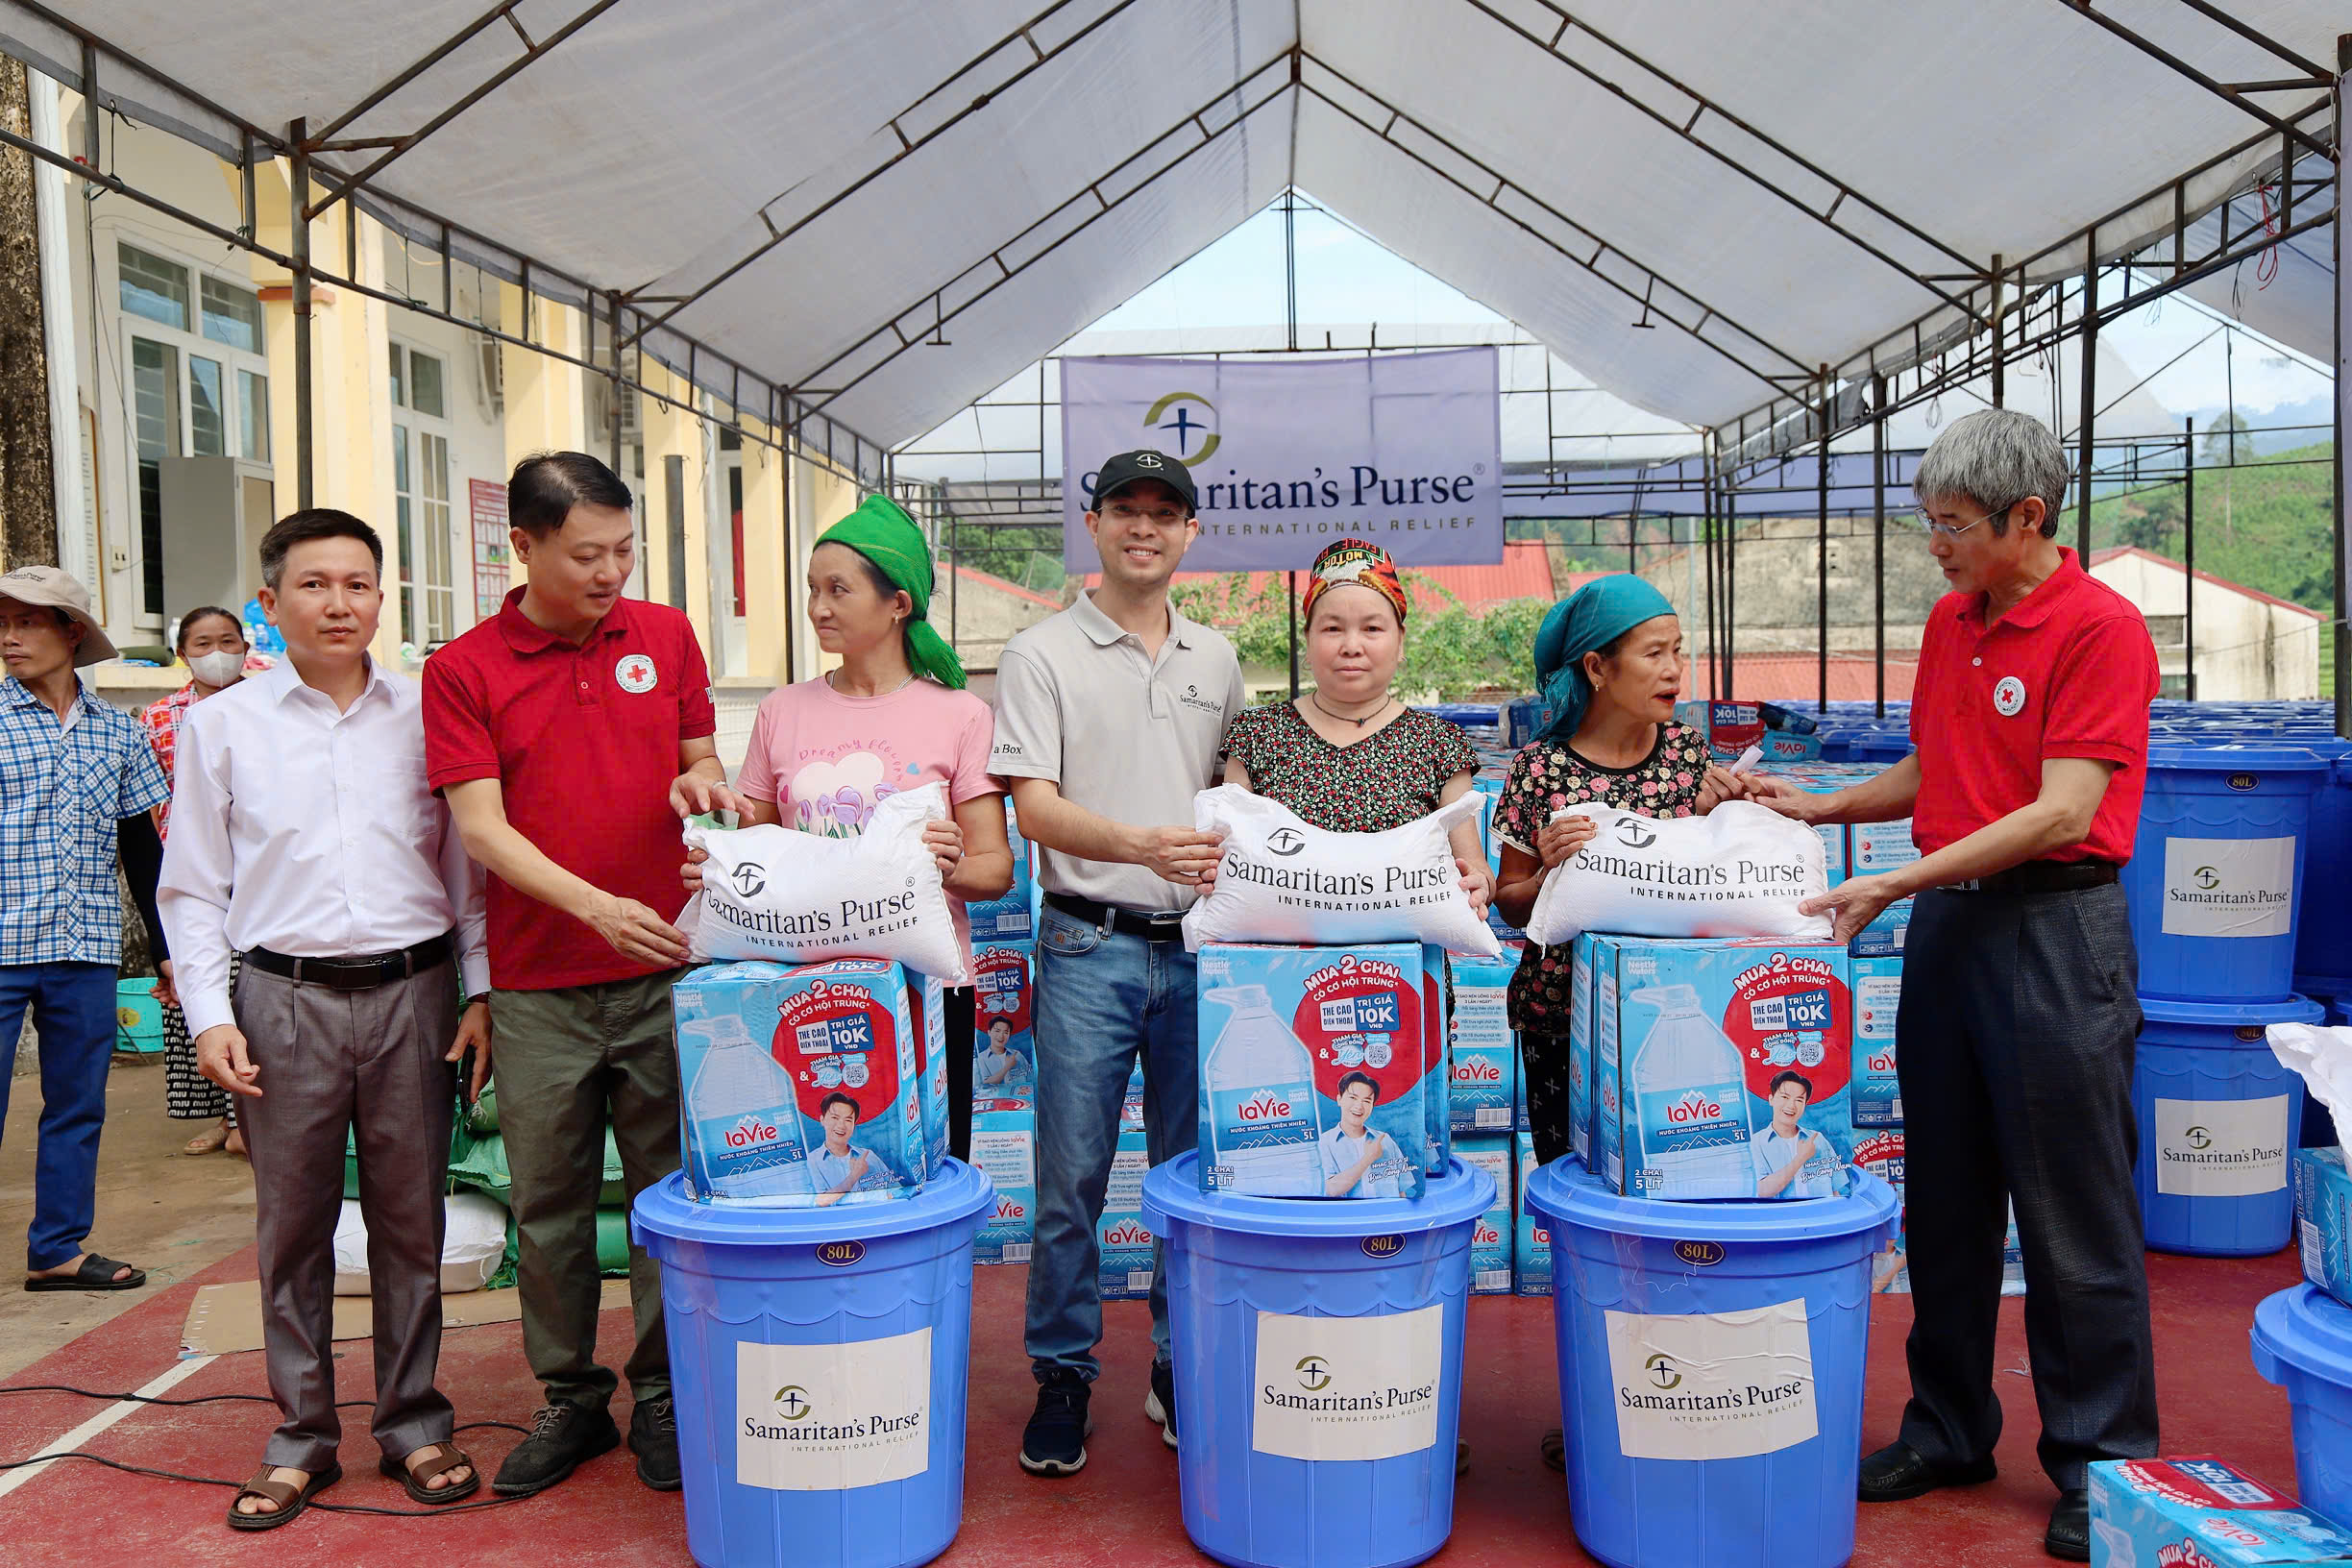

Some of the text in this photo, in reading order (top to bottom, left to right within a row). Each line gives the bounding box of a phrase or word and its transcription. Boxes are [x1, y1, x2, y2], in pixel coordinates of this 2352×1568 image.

[1197, 517, 1476, 536] NTERNATIONAL RELIEF
[1324, 551, 1363, 570] MOTOR
[1715, 708, 1737, 718] 10K
[1002, 744, 1022, 755] Box
[1775, 742, 1806, 754] laVie
[2232, 776, 2252, 787] 80L
[1225, 852, 1374, 895] Samaritan's
[1575, 847, 1727, 886] Samaritan's
[1278, 892, 1453, 912] INTERNATIONAL RELIEF
[1630, 886, 1806, 901] INTERNATIONAL RELIEF
[2169, 887, 2256, 904] Samaritan's
[746, 916, 919, 949] INTERNATIONAL RELIEF
[987, 945, 1023, 959] 2 CHAI
[1628, 960, 1656, 968] Nestlé
[1733, 953, 1832, 991] MUA 2 CHAI
[998, 975, 1021, 987] 10K
[1304, 955, 1400, 992] MUA 2 CHAI
[1312, 989, 1326, 1001] CÓ
[1327, 981, 1340, 992] CƠ
[1341, 975, 1360, 988] HỘI
[1743, 987, 1756, 1000] CÓ
[1756, 979, 1771, 992] CƠ
[1772, 973, 1791, 986] HỘI
[777, 979, 870, 1017] MUA 2 CHAI
[1357, 993, 1393, 1007] TRỊ GIÁ
[1787, 992, 1825, 1006] TRỊ GIÁ
[788, 1014, 801, 1026] CÓ
[800, 1006, 814, 1017] CƠ
[814, 999, 832, 1012] HỘI
[1336, 1004, 1352, 1015] CAO
[1357, 1006, 1395, 1023] 10K
[1768, 1002, 1783, 1014] CAO
[1788, 1004, 1827, 1021] 10K
[847, 1015, 866, 1027] GIÁ
[812, 1027, 826, 1038] CAO
[832, 1026, 870, 1045] 10K
[1332, 1034, 1350, 1043] THAM
[1762, 1033, 1782, 1043] THAM
[810, 1057, 827, 1066] THAM
[1868, 1053, 1897, 1071] laV
[1453, 1063, 1500, 1081] laVie
[1237, 1097, 1290, 1121] laVie
[1667, 1098, 1721, 1122] laVie
[725, 1122, 777, 1147] laVie
[1304, 1131, 1314, 1140] 5L
[1734, 1132, 1746, 1140] 5L
[1853, 1131, 1890, 1155] MUA 2
[792, 1151, 803, 1161] 5L
[2163, 1147, 2250, 1164] Samaritan's
[1402, 1163, 1419, 1172] Nam
[1835, 1162, 1852, 1171] Nam
[1208, 1174, 1235, 1186] 5 LÍT
[1635, 1177, 1663, 1189] 5 LÍT
[1105, 1226, 1151, 1245] laVie
[1473, 1226, 1499, 1243] Vie
[826, 1244, 855, 1260] 80L
[1370, 1237, 1397, 1252] 80L
[1682, 1243, 1714, 1261] 80L
[1262, 1384, 1384, 1410] Samaritan's
[1621, 1380, 1802, 1411] Samaritan's Purse
[1311, 1404, 1432, 1423] INTERNATIONAL RELIEF
[1669, 1399, 1804, 1423] INTERNATIONAL RELIEF
[745, 1416, 866, 1441] Samaritan's
[791, 1430, 920, 1453] INTERNATIONAL RELIEF
[2206, 1518, 2266, 1546] laVie
[2158, 1543, 2184, 1568] MUA
[2183, 1538, 2196, 1565] 2
